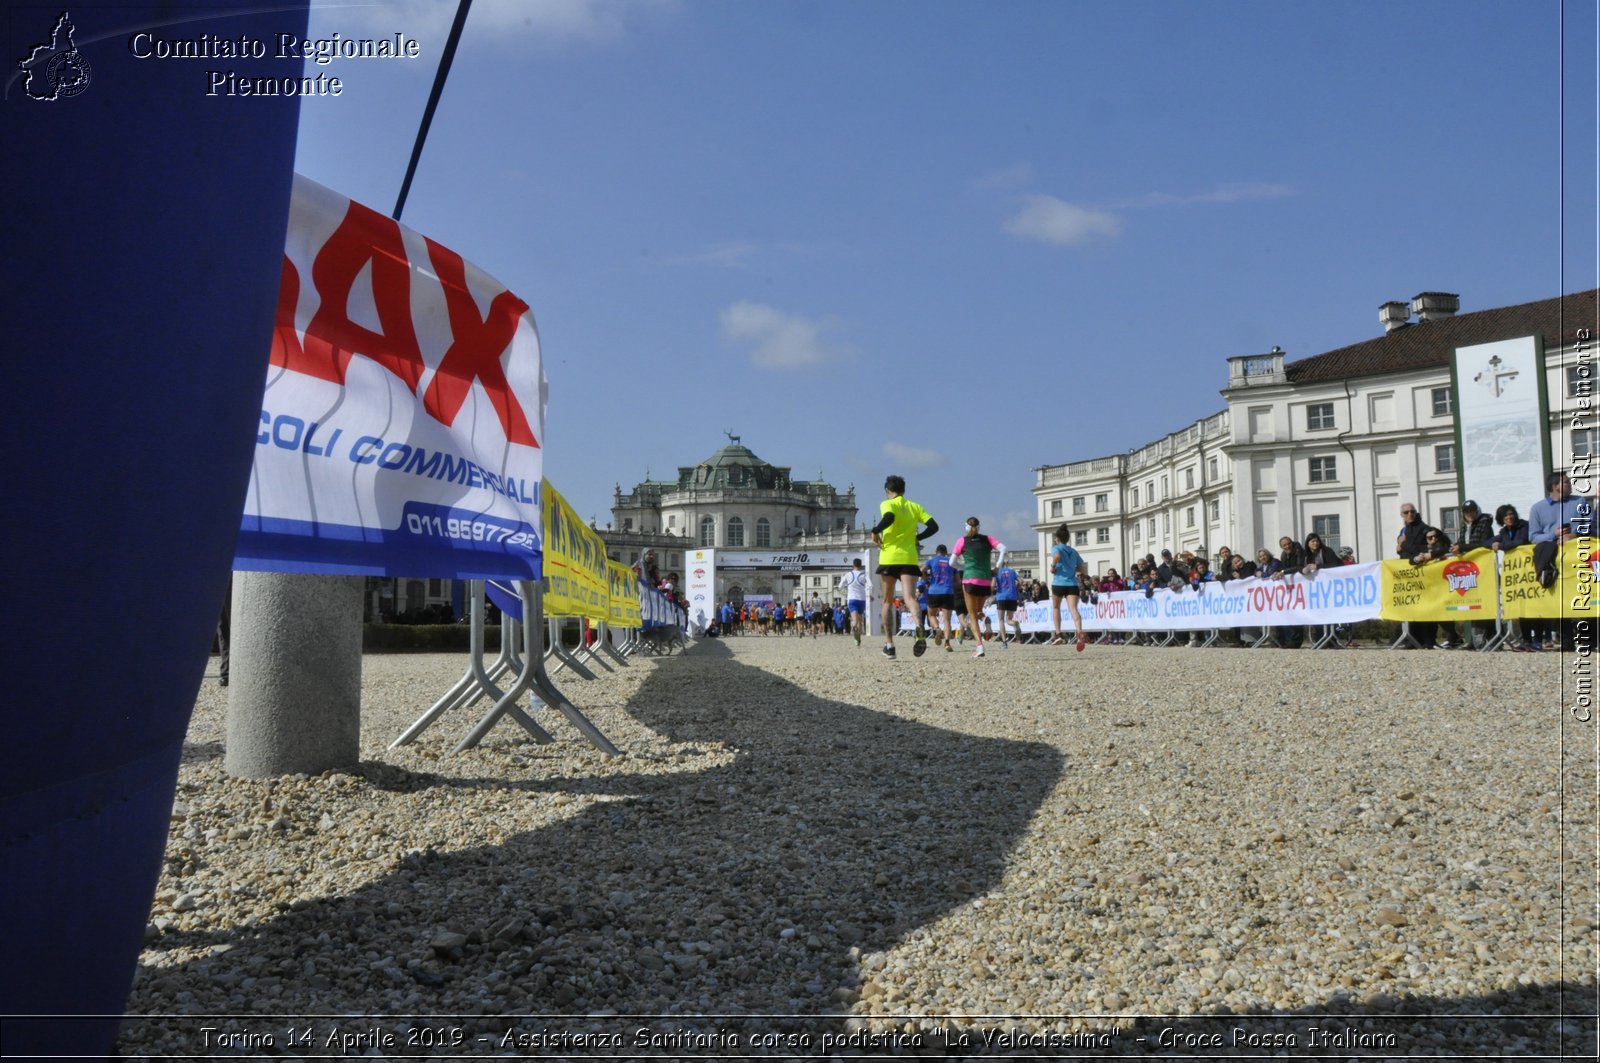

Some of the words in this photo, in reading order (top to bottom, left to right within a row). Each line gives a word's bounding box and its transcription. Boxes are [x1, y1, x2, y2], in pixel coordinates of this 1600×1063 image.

[1095, 599, 1126, 620] TOYOTA
[1127, 598, 1158, 619] HYBRID
[1165, 595, 1200, 618] Central
[1202, 591, 1245, 616] Motors
[1247, 583, 1306, 613] TOYOTA
[1309, 575, 1377, 610] HYBRID
[1446, 570, 1478, 593] Biraghi
